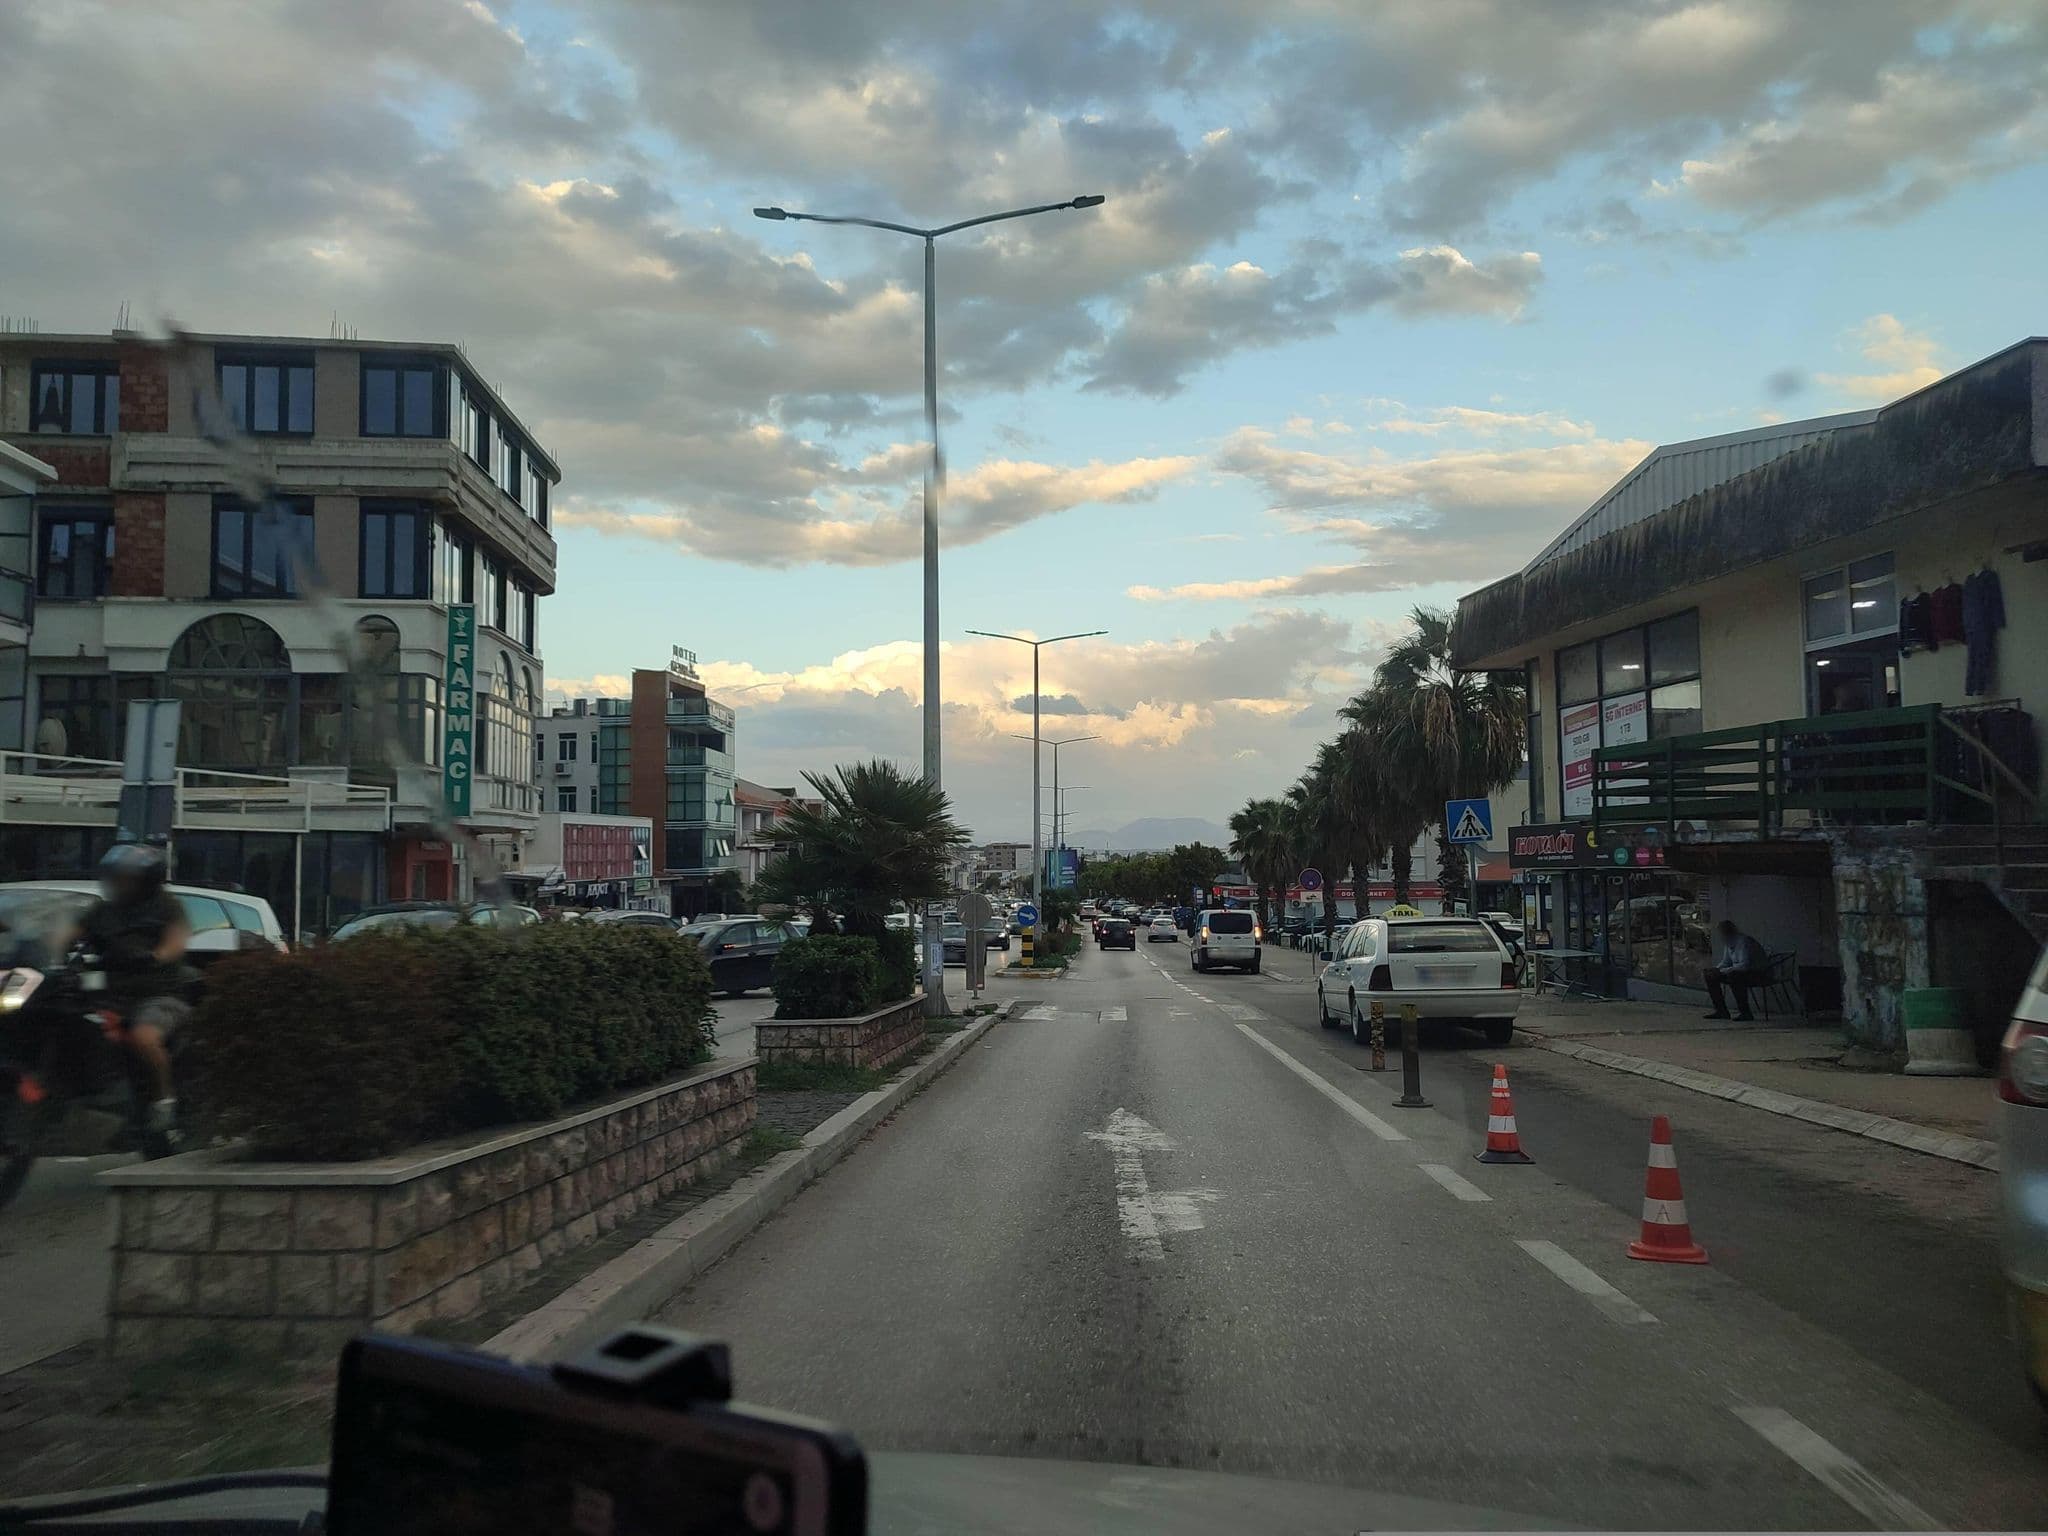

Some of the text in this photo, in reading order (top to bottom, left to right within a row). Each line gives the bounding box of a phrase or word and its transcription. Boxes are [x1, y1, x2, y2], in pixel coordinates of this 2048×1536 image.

[673, 644, 697, 664] HOTEL
[1615, 699, 1648, 719] INTERNET
[447, 644, 471, 802] FARMACI
[1514, 829, 1575, 855] KOVAČI
